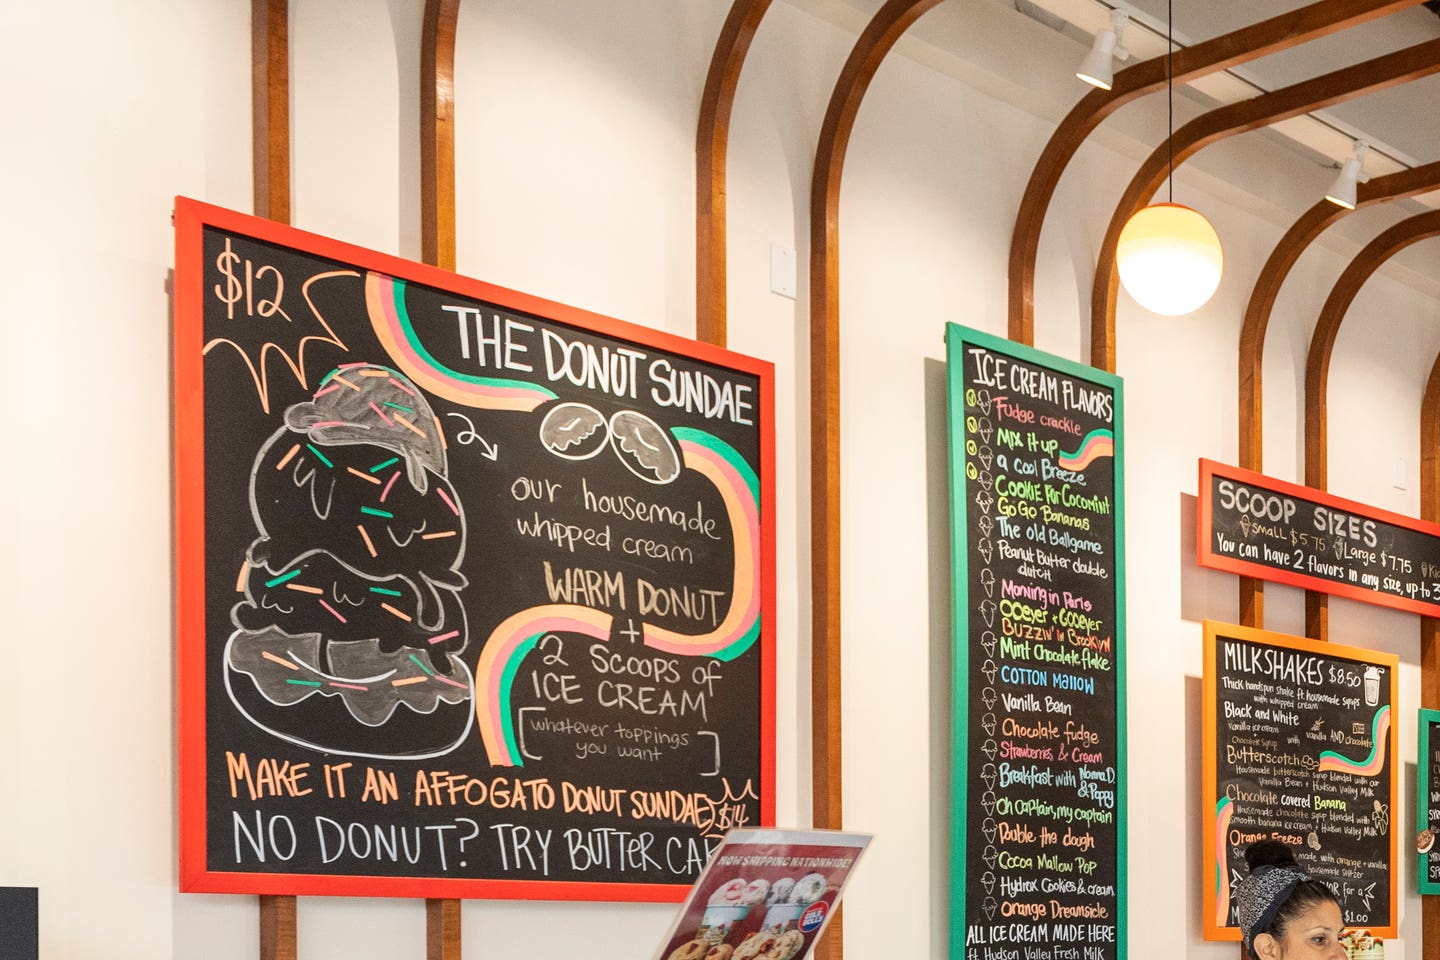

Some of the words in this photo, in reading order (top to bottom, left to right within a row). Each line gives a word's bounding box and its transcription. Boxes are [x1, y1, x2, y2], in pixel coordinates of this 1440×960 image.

[215, 237, 292, 322] $12
[441, 305, 534, 373] THE
[544, 328, 646, 398] DONUT
[649, 359, 754, 426] SUNDAE
[968, 349, 1007, 390] ICE
[1010, 364, 1058, 404] CREAM
[1062, 380, 1113, 423] FLAVORS
[992, 396, 1035, 424] Fudge
[1040, 415, 1082, 436] crackle
[1027, 432, 1039, 452] it
[1040, 439, 1058, 458] up
[996, 454, 1008, 473] a
[1013, 458, 1038, 477] cool
[1041, 458, 1086, 486] Breeze
[511, 476, 562, 502] our
[582, 478, 721, 540] housemade
[997, 497, 1017, 517] Go
[1018, 501, 1037, 518] Go
[1040, 504, 1090, 531] Bananas
[1218, 480, 1296, 525] SCOOP
[1313, 506, 1378, 548] SIZES
[517, 512, 611, 552] whipped
[622, 537, 694, 564] cream
[996, 516, 1021, 539] The
[1026, 523, 1046, 543] old
[1049, 528, 1104, 555] Ballgame
[1290, 528, 1326, 551] $5.75
[1343, 541, 1377, 567] Large
[1380, 550, 1413, 574] $7.75
[1216, 532, 1235, 553] You
[1238, 541, 1259, 559] can
[1263, 543, 1290, 567] have
[1293, 549, 1305, 570] 2
[1307, 555, 1345, 579] flavors
[1348, 567, 1358, 582] in
[1361, 574, 1380, 592] any
[1382, 575, 1404, 597] size,
[1406, 582, 1418, 600] up
[1419, 581, 1431, 599] to
[543, 560, 626, 610] WARM
[637, 578, 726, 626] DONUT
[1049, 588, 1060, 606] in
[538, 635, 569, 666] 2
[589, 644, 681, 685] SCOOPS
[692, 660, 722, 697] of
[1000, 636, 1031, 660] Mint
[1033, 643, 1081, 666] Chocolate
[1081, 647, 1111, 671] flake
[1224, 642, 1324, 686] MILKSHAKES
[1328, 665, 1361, 688] $8.50
[1001, 665, 1048, 687] COTTON
[531, 670, 584, 705] ICE
[598, 680, 707, 722] CREAM
[1001, 693, 1042, 713] Vanilla
[1045, 695, 1072, 716] Bean
[1224, 700, 1252, 720] Black
[1254, 709, 1270, 721] and
[1272, 710, 1300, 726] White
[531, 717, 609, 738] whatever
[614, 721, 690, 748] toppings
[1002, 717, 1060, 739] Chocolate
[1063, 720, 1099, 749] fudge
[576, 739, 607, 759] you
[617, 745, 663, 761] want
[999, 740, 1054, 762] Strawberries
[1057, 742, 1069, 761] &
[1071, 747, 1103, 764] Cream
[1226, 744, 1300, 766] Butterscotch
[226, 751, 312, 802] MAKE
[324, 761, 353, 800] IT
[361, 765, 400, 802] AN
[414, 770, 555, 811] AFFOGATO
[562, 781, 626, 817] DONUT
[630, 789, 711, 829] SUNDAE
[1226, 784, 1278, 805] Chocolate
[1280, 793, 1311, 808] covered
[1313, 795, 1347, 811] Banana
[714, 802, 750, 831] $14
[233, 809, 298, 864] NO
[315, 817, 480, 872] DONUT?
[489, 823, 552, 876] TRY
[1039, 826, 1058, 848] the
[1062, 827, 1095, 853] dough
[718, 855, 742, 866] NOW
[743, 856, 790, 867] SHIPPING
[789, 856, 853, 869] NATIONWIDE!
[998, 851, 1033, 870] Cocoa
[1037, 853, 1073, 873] Mallow
[1074, 857, 1098, 876] Pop
[1001, 900, 1047, 921] Orange
[1049, 899, 1109, 919] Dreamsicle
[1344, 911, 1369, 923] $1.00
[965, 924, 986, 947] ALL
[989, 924, 1007, 943] ICE
[1009, 922, 1049, 943] CREAM
[1052, 924, 1086, 942] MADE
[1088, 924, 1115, 942] HERE
[1053, 945, 1080, 960] Fresh
[1083, 946, 1105, 960] Milk
